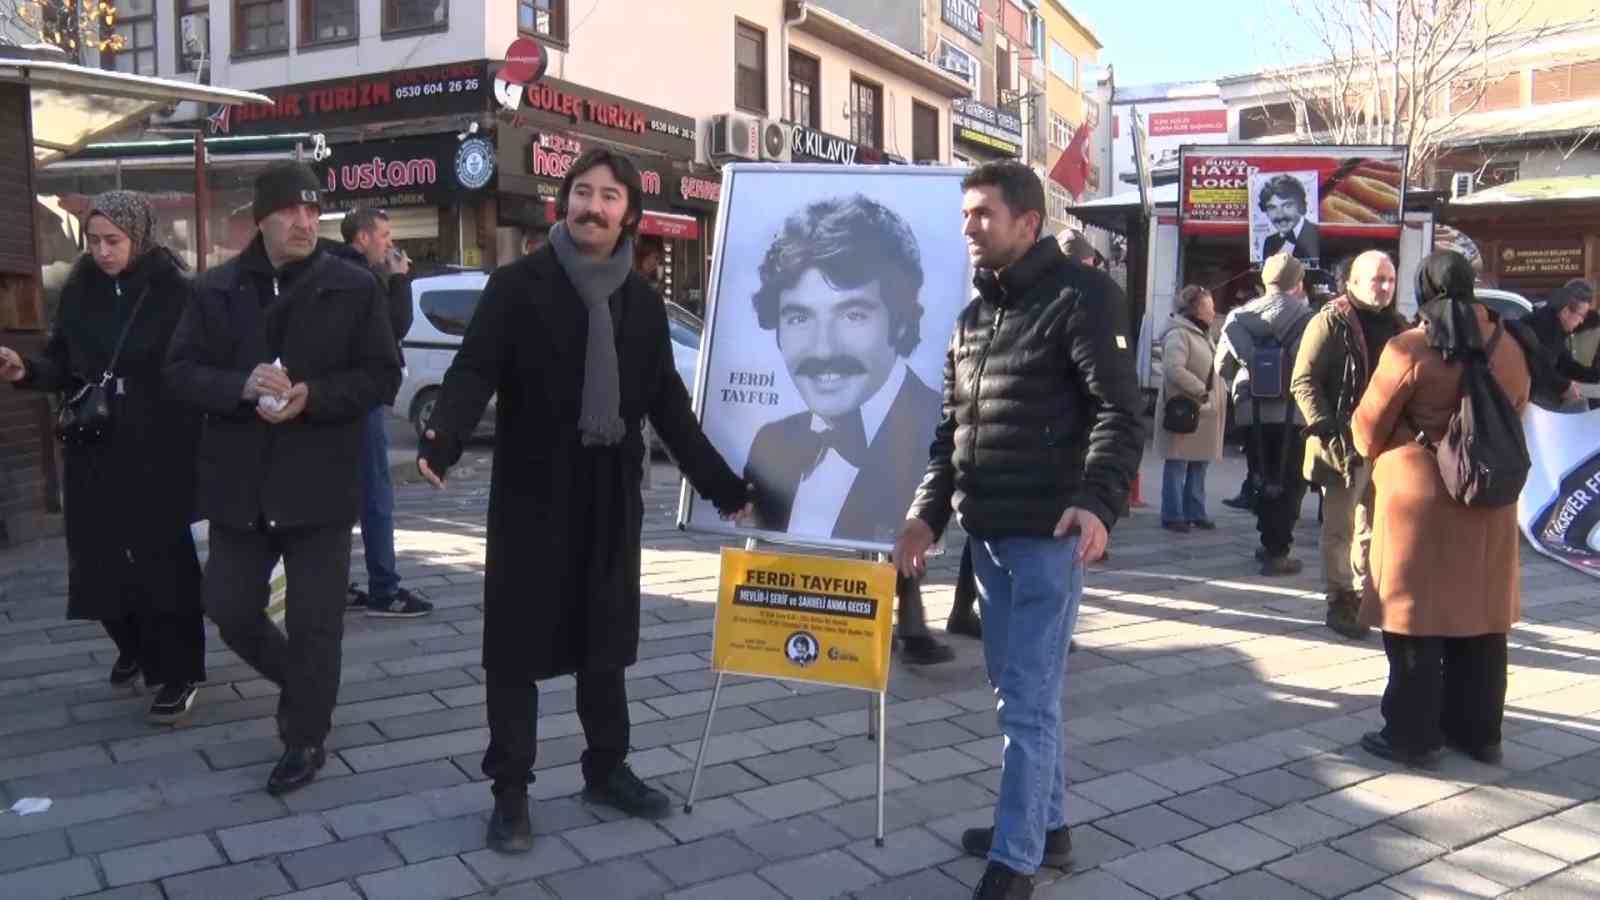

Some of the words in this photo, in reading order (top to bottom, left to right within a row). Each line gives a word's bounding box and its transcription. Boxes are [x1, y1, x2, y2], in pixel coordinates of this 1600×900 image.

[395, 85, 421, 98] 0530
[423, 82, 442, 95] 604
[448, 80, 462, 92] 26
[465, 79, 479, 90] 26
[588, 101, 646, 134] TURİZM
[804, 130, 858, 168] KILAVUZ
[341, 156, 437, 191] ustam
[729, 371, 775, 386] FERDİ
[721, 388, 778, 405] TAYFUR
[800, 574, 868, 595] TAYFUR
